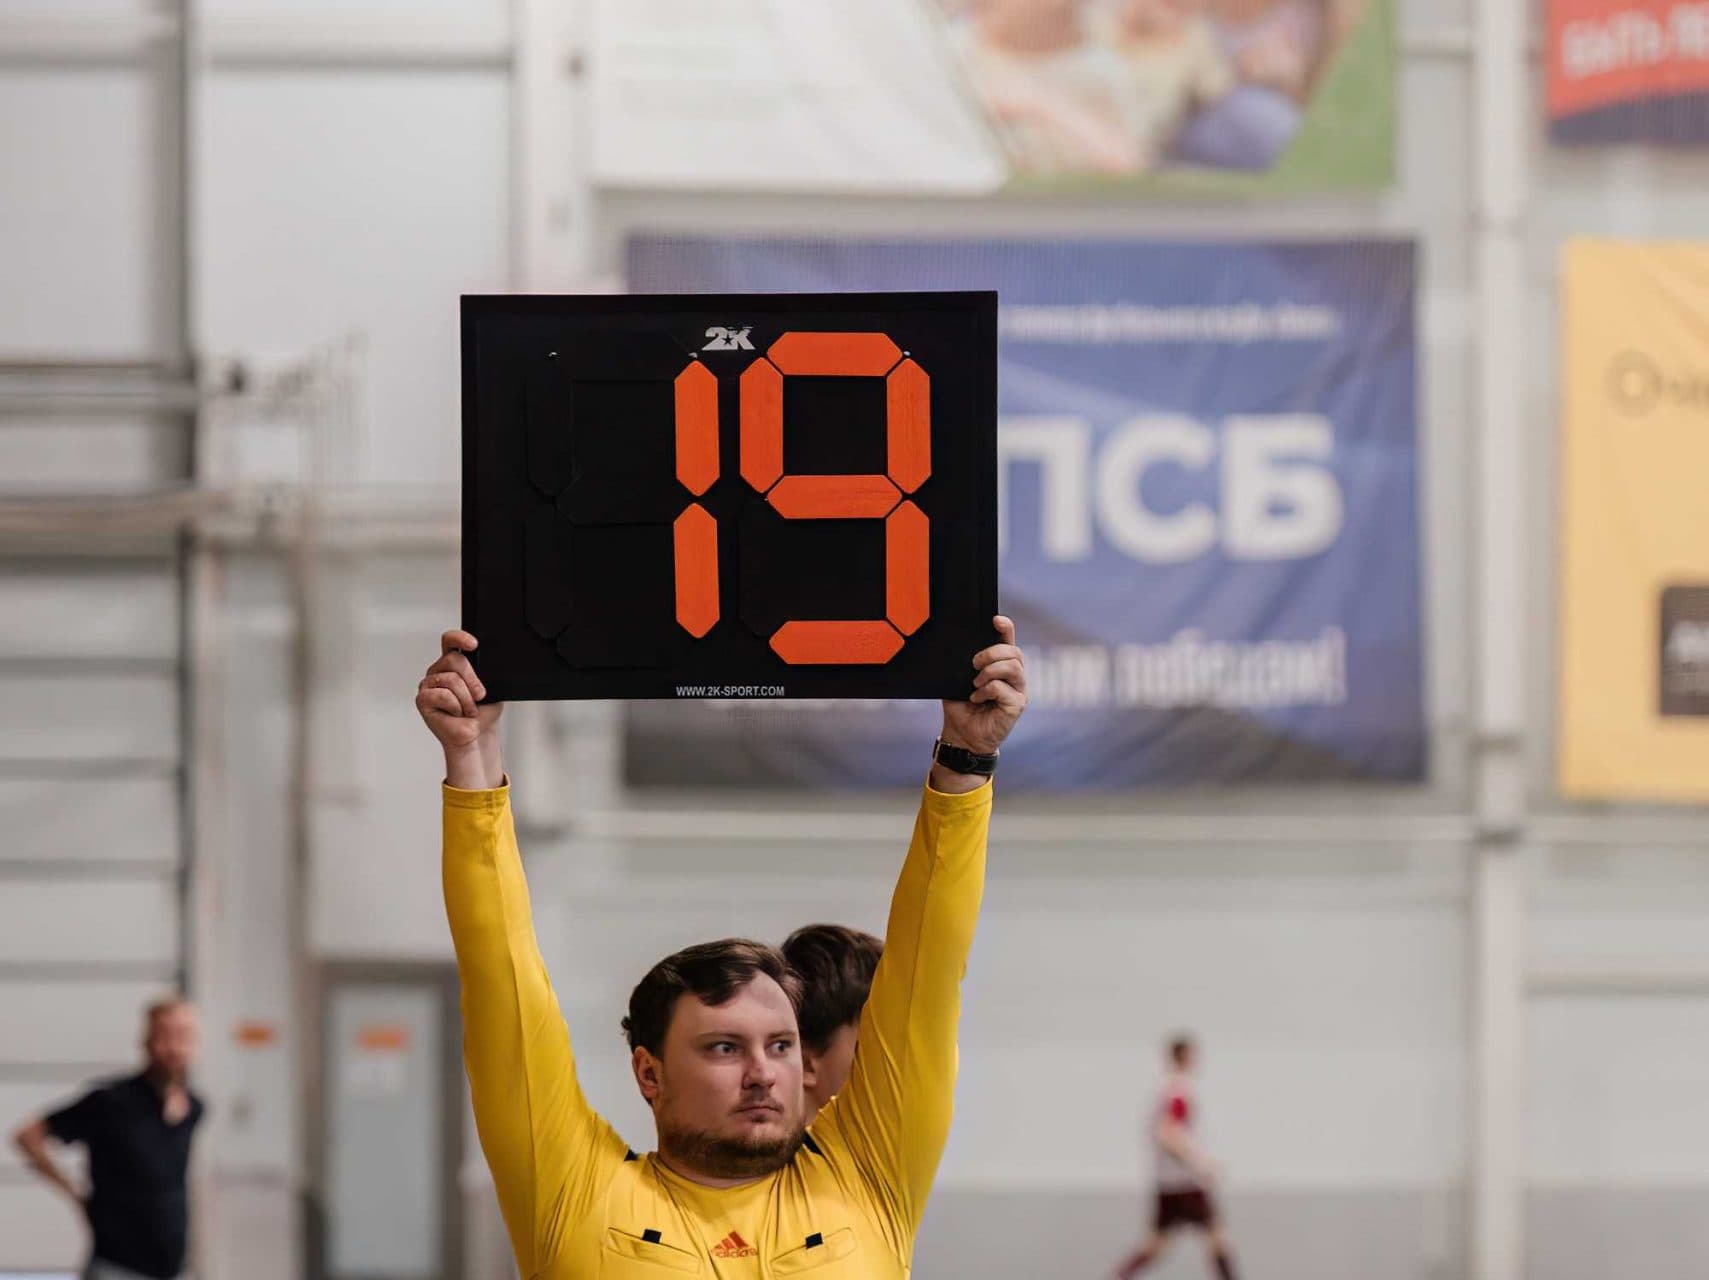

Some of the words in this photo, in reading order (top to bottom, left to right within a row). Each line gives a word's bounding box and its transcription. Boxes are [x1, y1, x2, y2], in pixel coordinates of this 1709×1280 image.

[702, 326, 756, 350] 2K
[673, 331, 931, 665] 19
[997, 412, 1346, 565] ПСБ
[676, 686, 785, 697] WWW.2K-SPORT.COM
